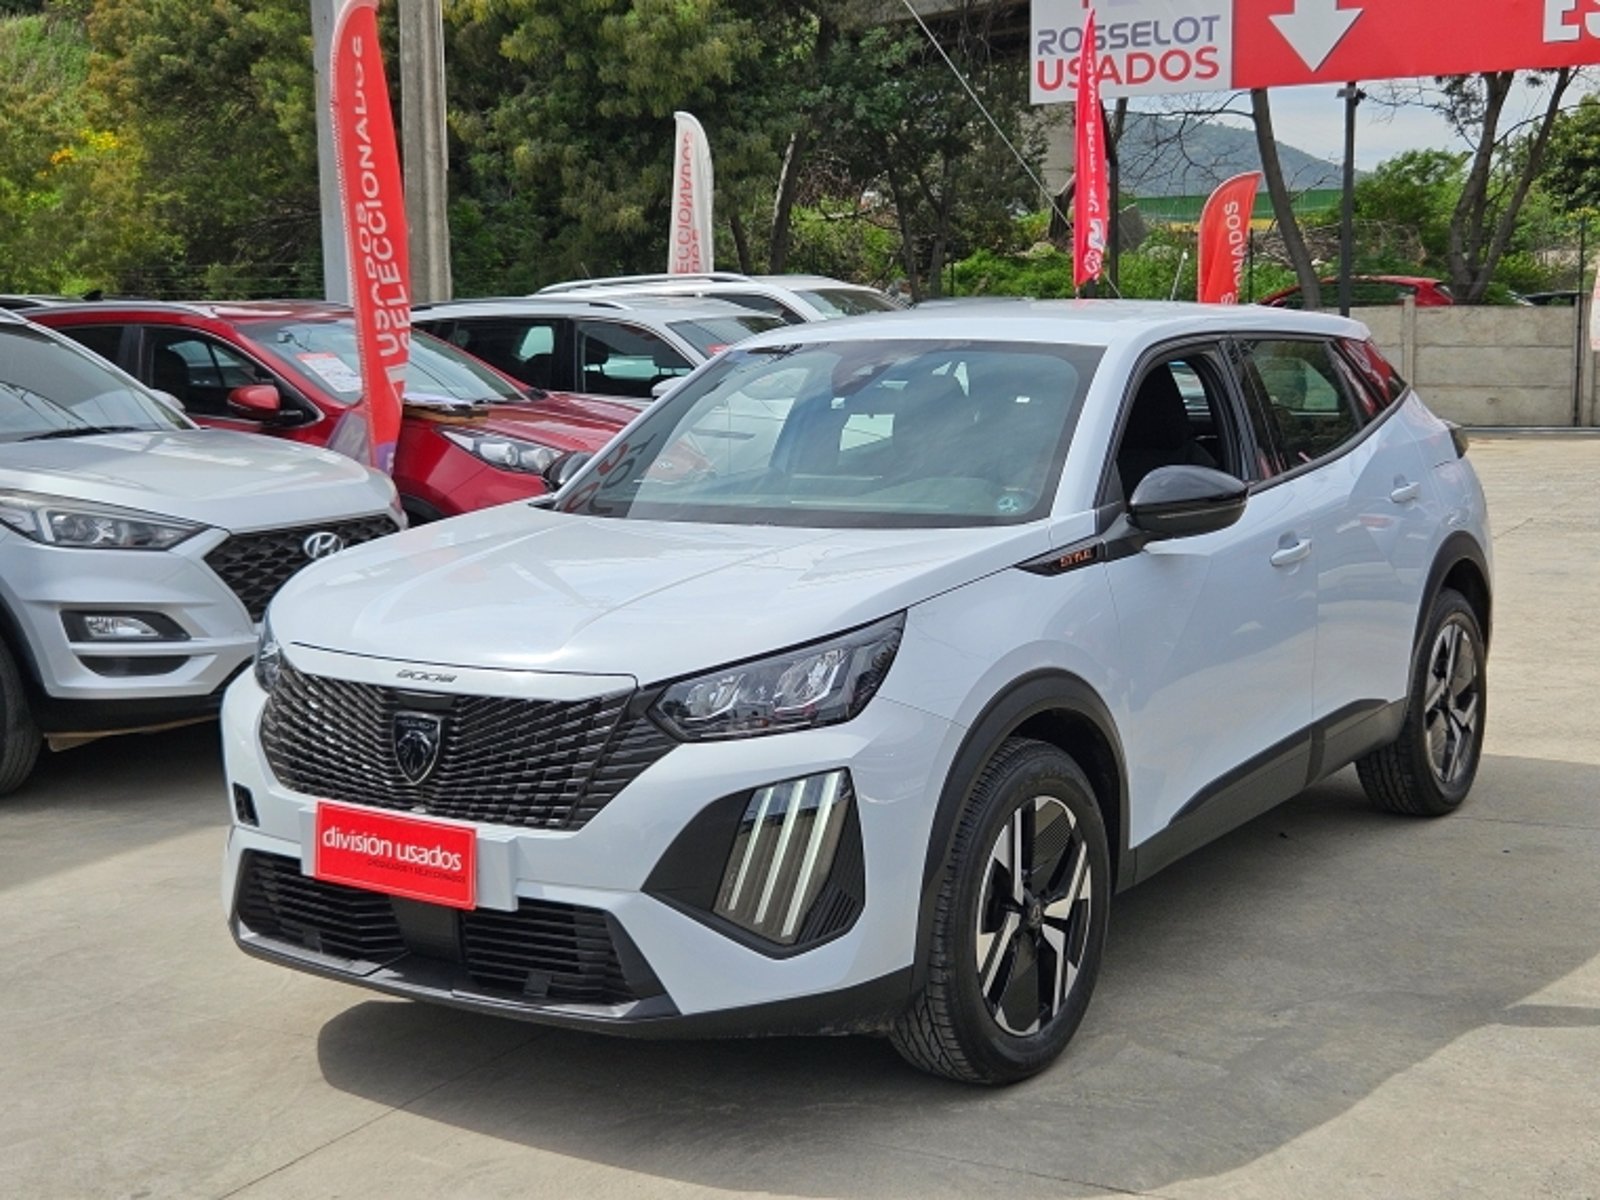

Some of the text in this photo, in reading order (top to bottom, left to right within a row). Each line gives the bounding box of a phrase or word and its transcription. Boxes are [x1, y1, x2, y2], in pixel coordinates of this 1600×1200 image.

[1038, 15, 1221, 55] ROSSELOT
[1543, 0, 1600, 42] E
[1038, 46, 1220, 91] USADOS
[322, 826, 393, 858] división
[395, 845, 463, 872] usados
